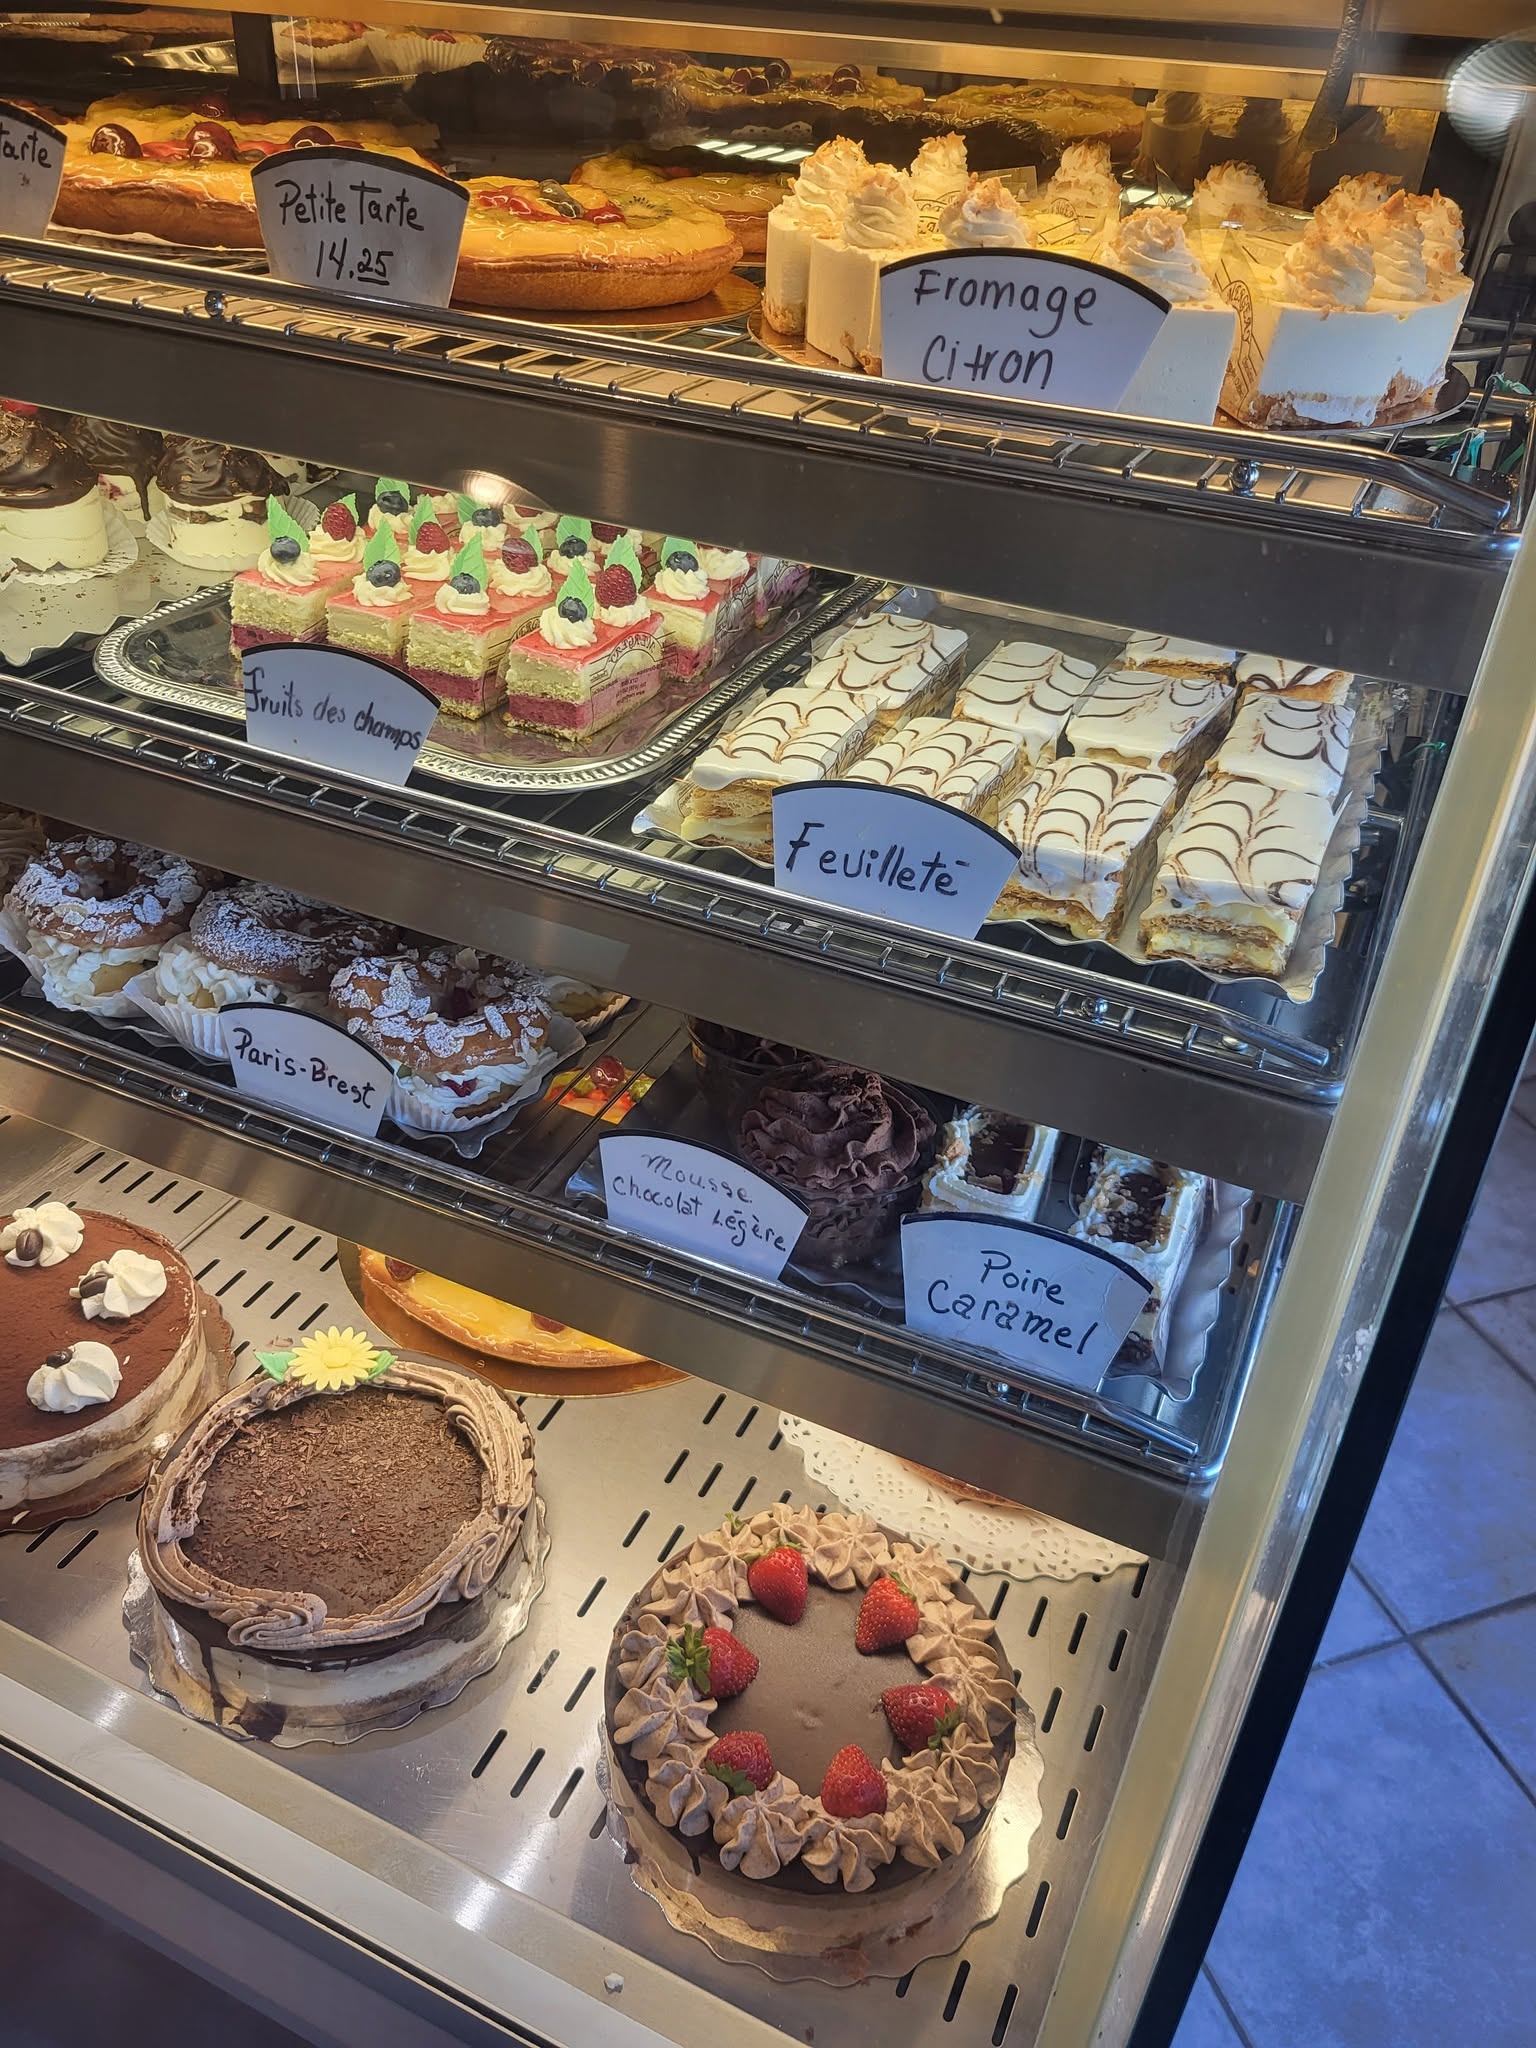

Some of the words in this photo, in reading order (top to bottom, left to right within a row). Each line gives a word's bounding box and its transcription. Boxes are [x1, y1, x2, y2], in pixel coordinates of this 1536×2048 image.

[274, 179, 346, 225] Petite
[349, 181, 425, 231] Tarte
[316, 237, 394, 285] 14.25
[914, 269, 1097, 339] Fromage
[922, 335, 1053, 390] Citron
[313, 693, 346, 724] des
[353, 701, 423, 751] champs
[785, 822, 971, 897] Feuilleté
[233, 1027, 376, 1109] Paris-Brest
[641, 1153, 753, 1204] Mousse
[980, 1250, 1065, 1305] Poire
[927, 1279, 1099, 1355] Caramel
